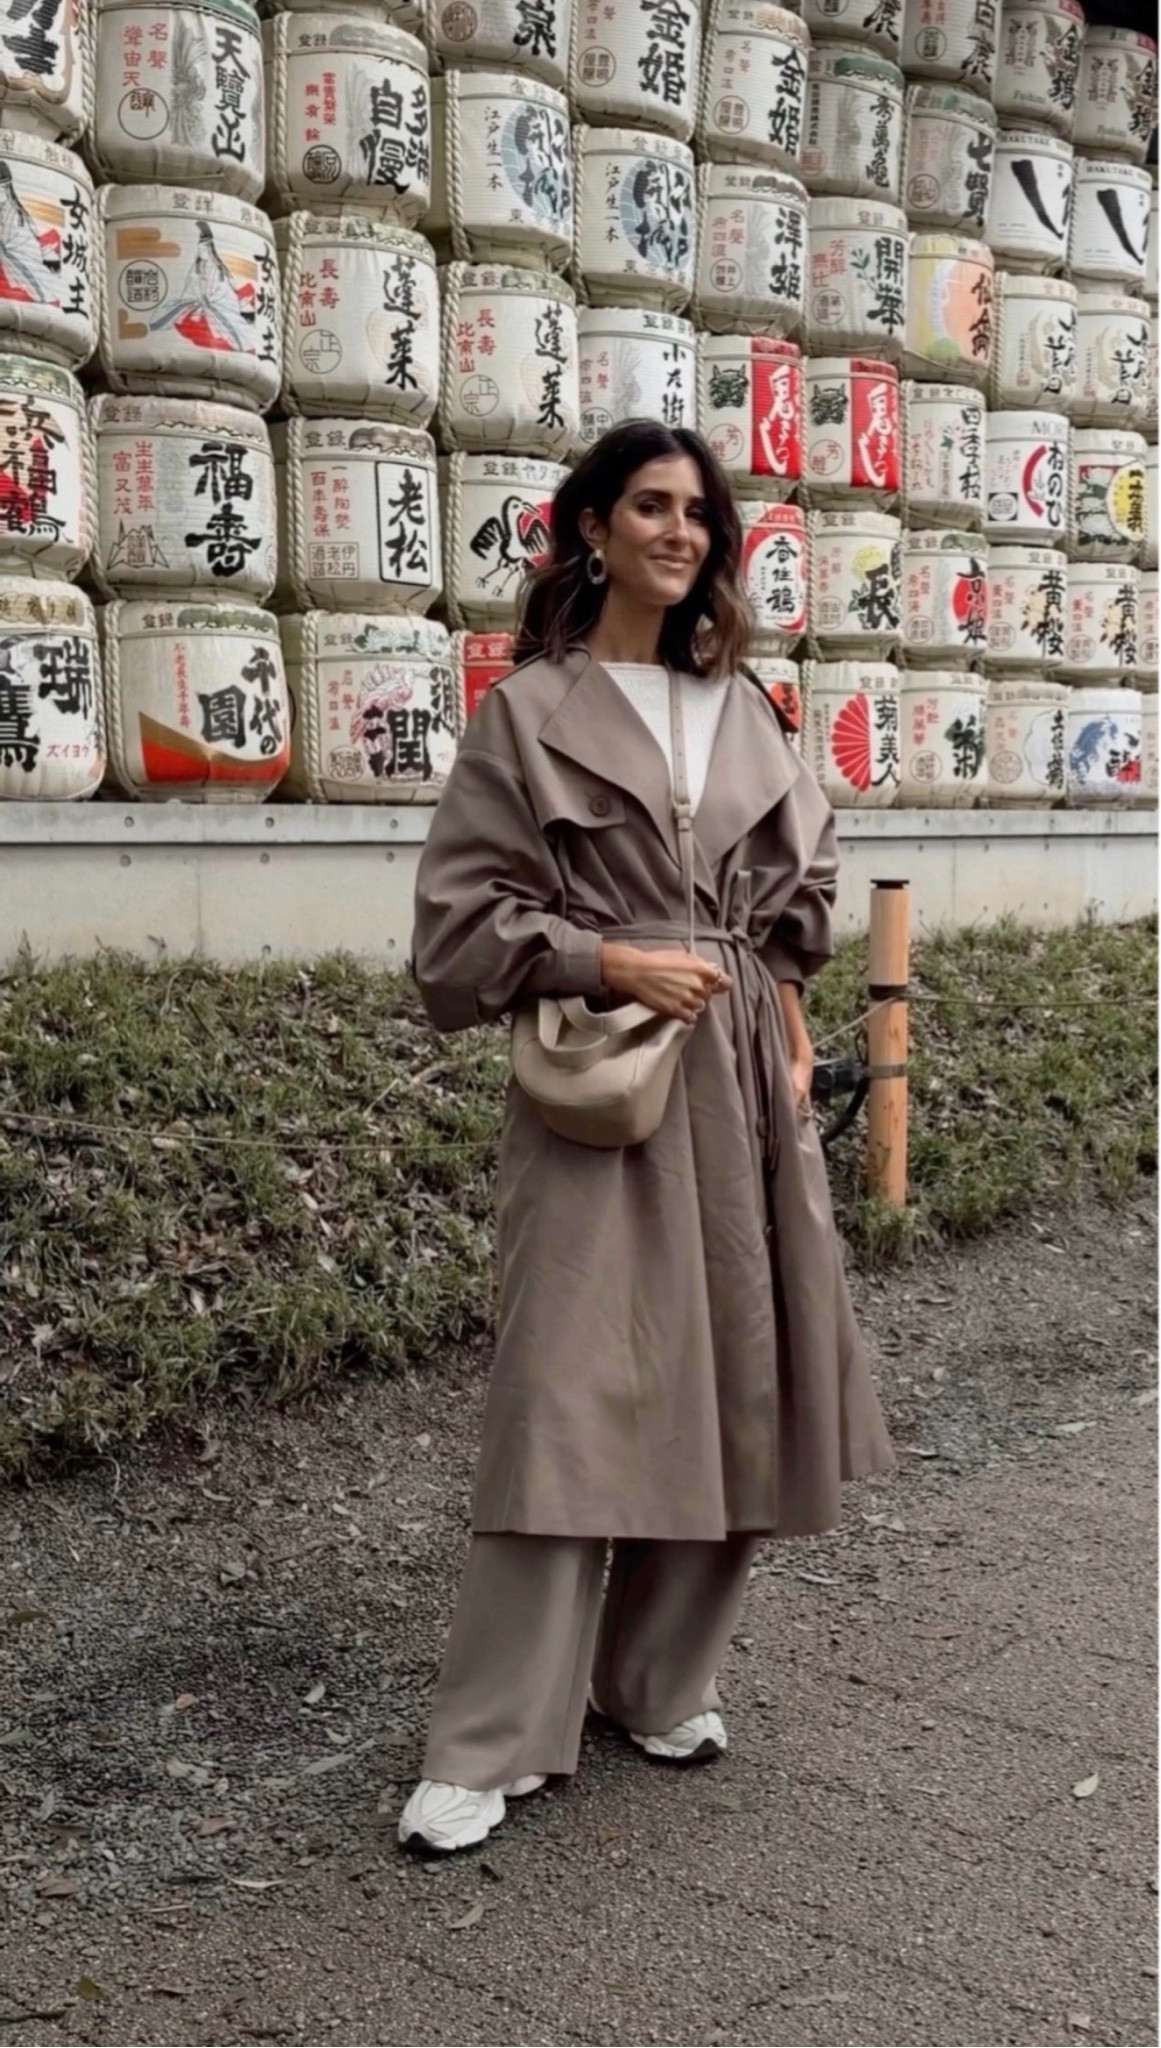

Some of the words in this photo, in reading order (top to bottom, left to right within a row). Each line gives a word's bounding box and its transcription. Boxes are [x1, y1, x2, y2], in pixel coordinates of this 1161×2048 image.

[359, 78, 411, 195] 自慢
[768, 48, 805, 156] 金婚
[60, 184, 90, 319] 女城主
[866, 236, 906, 335] 開華
[253, 241, 278, 365] 女城主
[383, 256, 422, 391] 蓬莱
[535, 303, 568, 429] 蓬莱
[304, 429, 347, 449] 登録
[483, 461, 518, 476] 登録
[1045, 440, 1066, 528] ねのひ
[385, 468, 428, 578] 老松
[765, 535, 798, 614] 香住鶴
[1030, 569, 1066, 657] 黄桜
[1109, 585, 1138, 666] 黄桜
[46, 744, 90, 759] ズイヨウ
[870, 694, 900, 788] 菊美人
